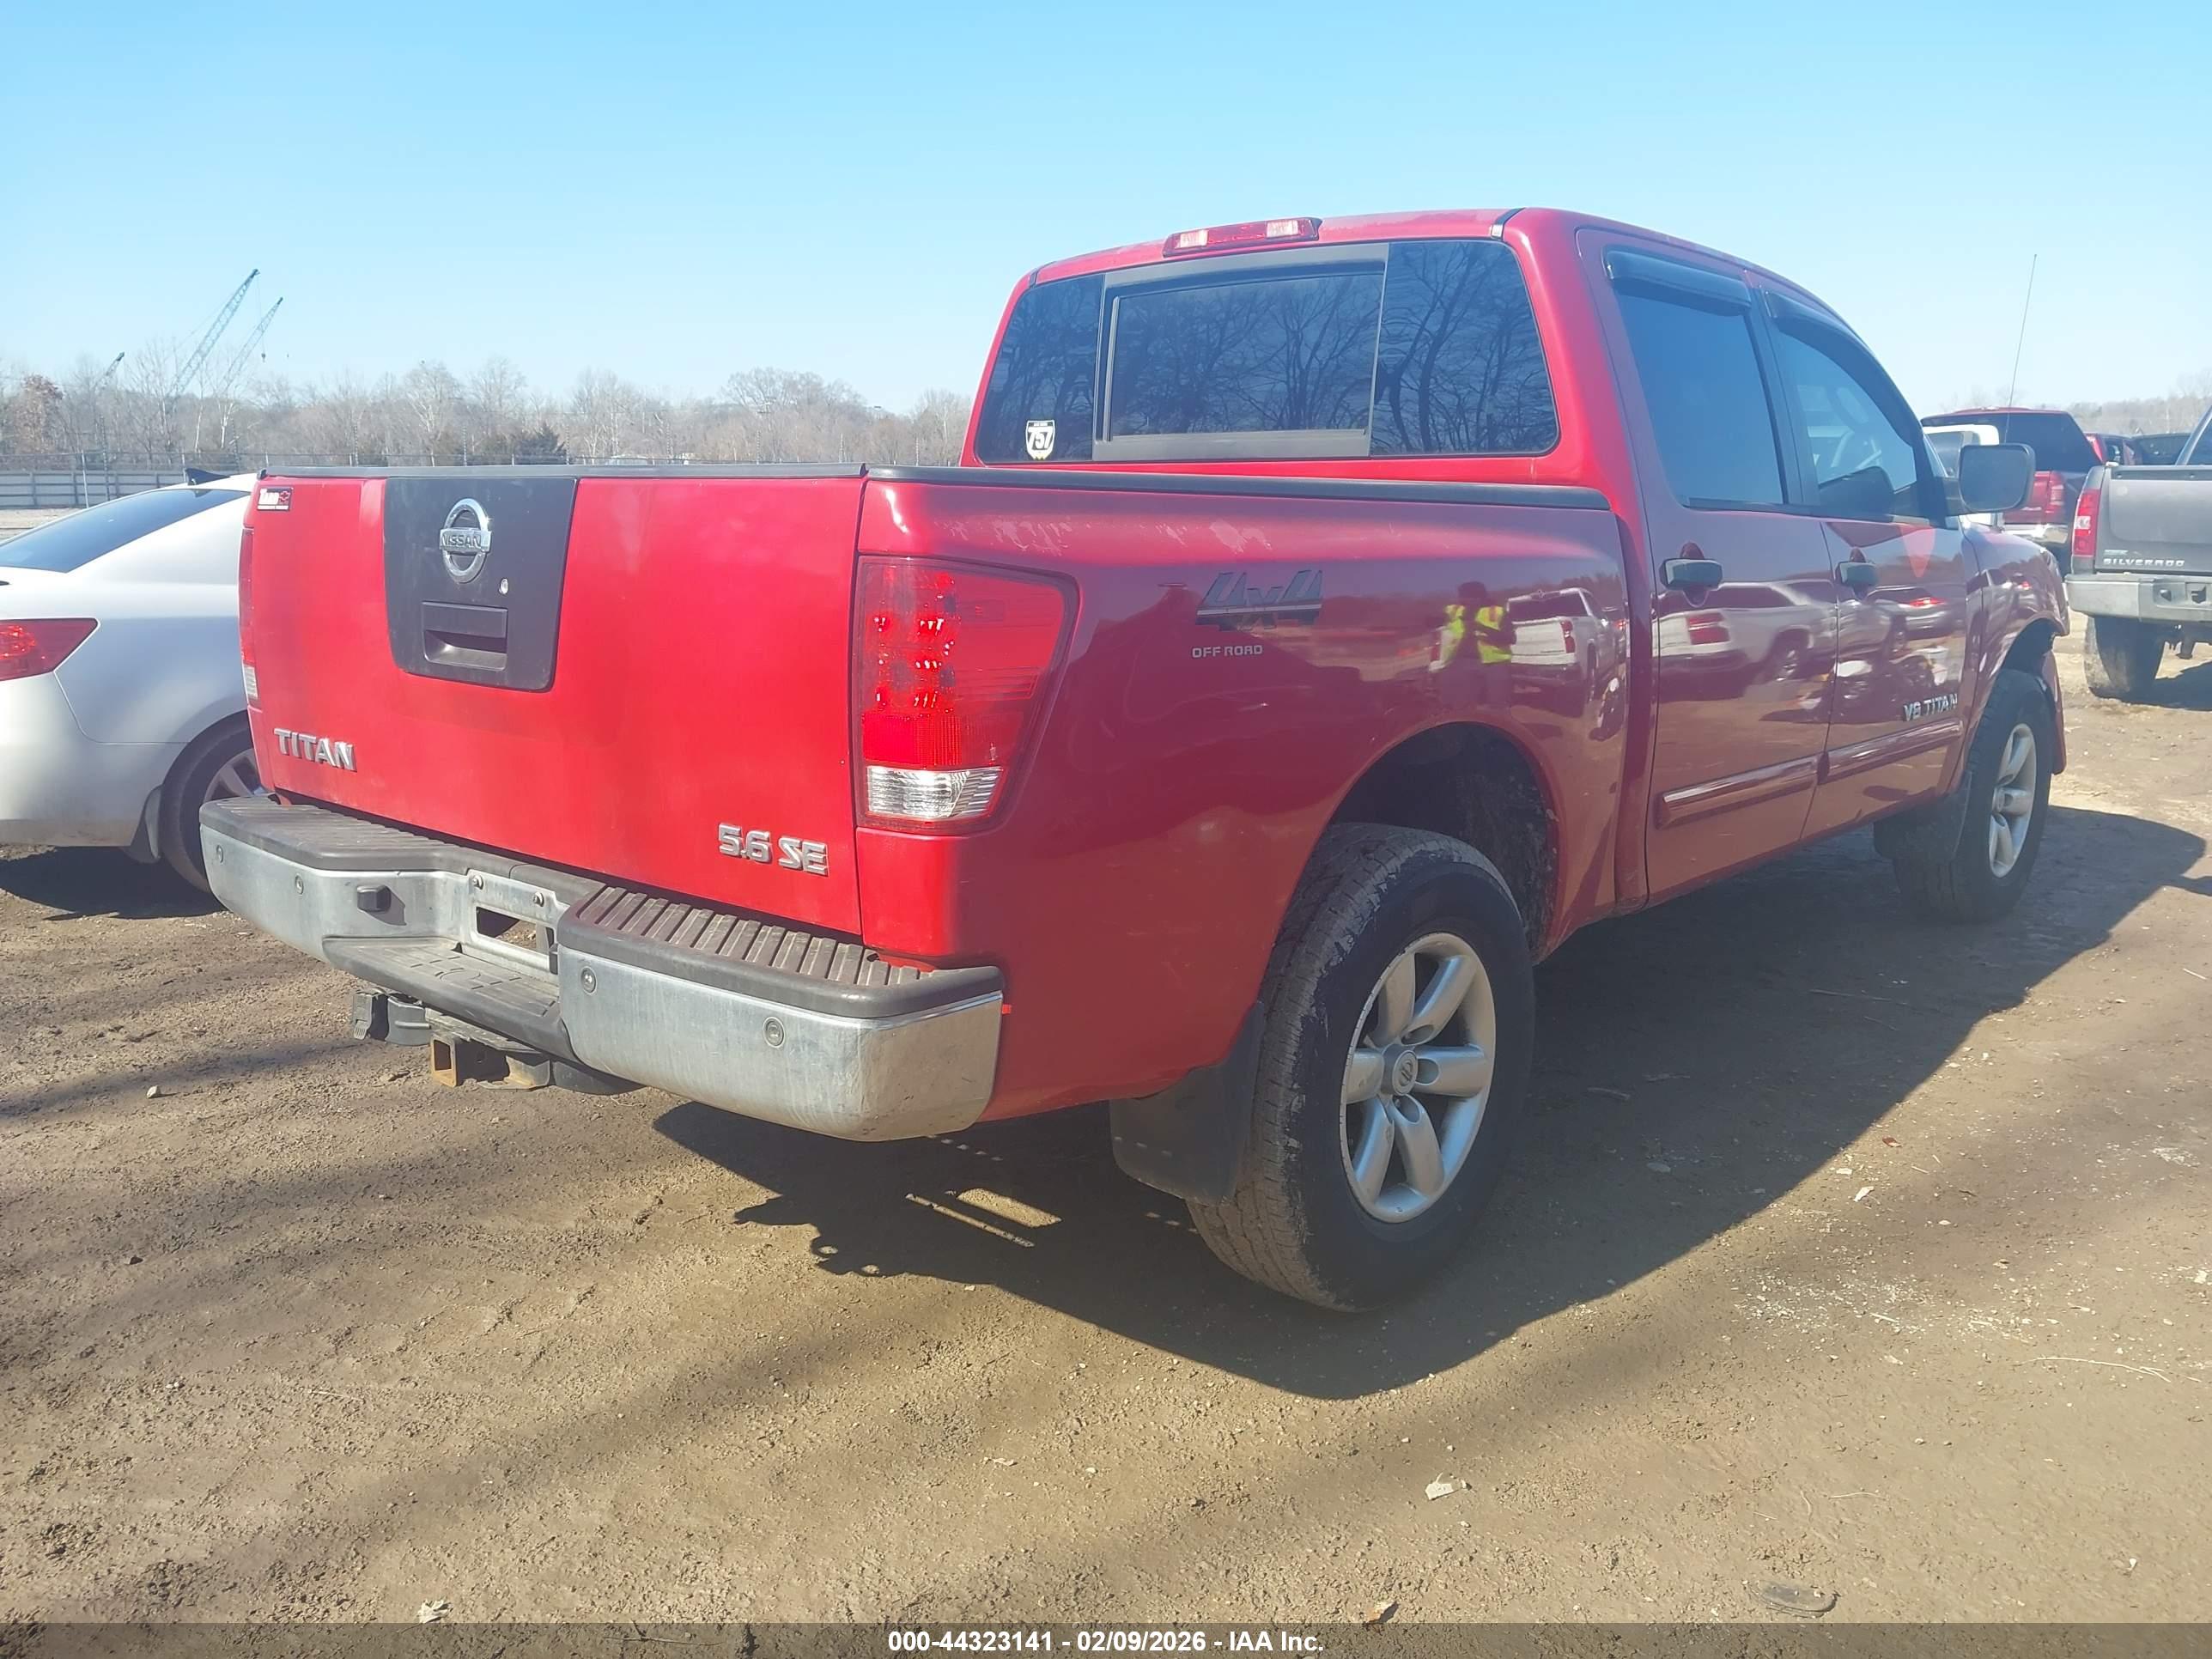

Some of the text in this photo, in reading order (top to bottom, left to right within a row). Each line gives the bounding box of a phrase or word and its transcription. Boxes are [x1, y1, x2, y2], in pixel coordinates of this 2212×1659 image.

[1028, 427, 1054, 449] 757
[441, 533, 482, 549] NISSAN
[2103, 558, 2185, 567] SILVERADO
[1192, 644, 1263, 659] OFF ROAD
[1923, 692, 1958, 715] TITAN
[274, 727, 356, 772] TITAN
[718, 823, 829, 877] 5.6 SE
